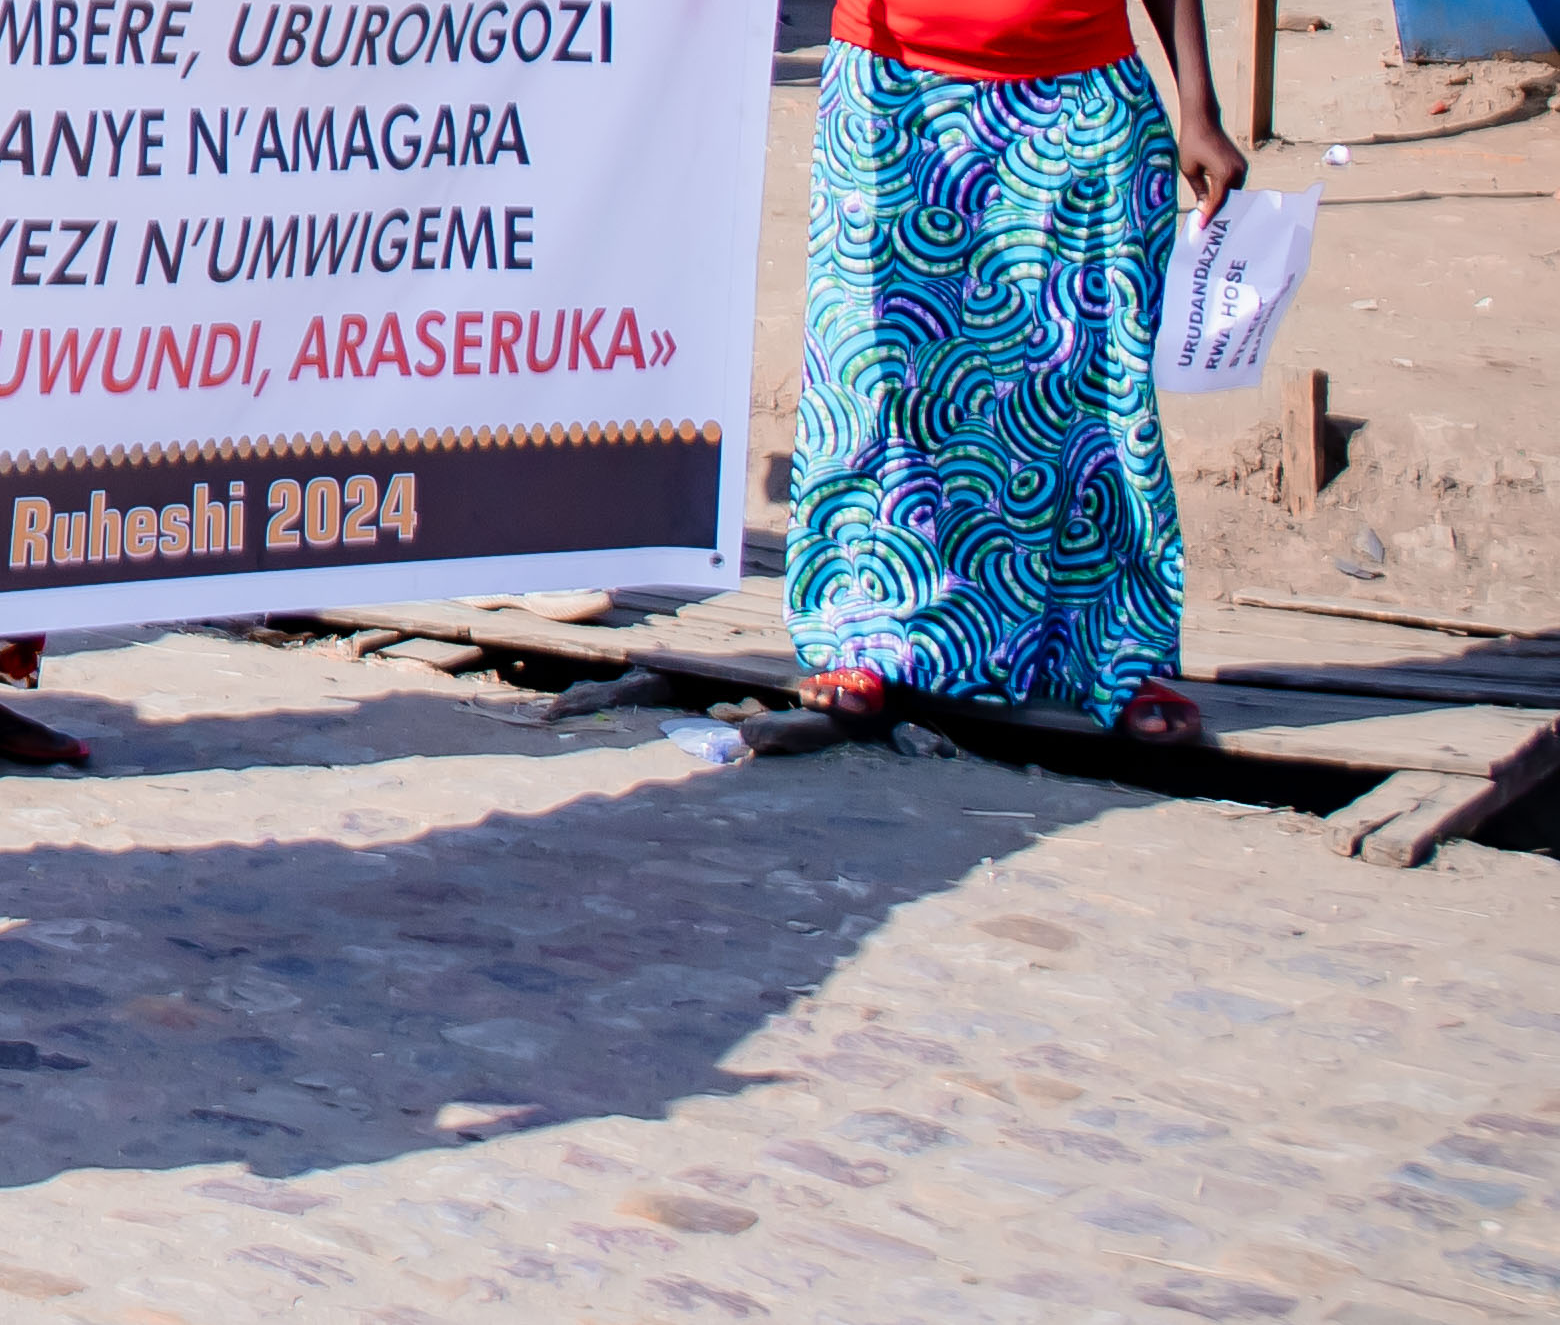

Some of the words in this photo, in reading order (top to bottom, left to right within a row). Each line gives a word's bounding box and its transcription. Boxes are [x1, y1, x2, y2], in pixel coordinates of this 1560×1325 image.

[187, 101, 531, 175] N'AMAGARA
[136, 206, 534, 286] N'UMWIGEME
[1178, 218, 1231, 367] URUDANDAZWA
[1206, 329, 1230, 369] RWA
[1221, 260, 1247, 318] HOSE
[287, 306, 678, 383] ARASERUKA»
[10, 481, 245, 569] Ruheshi
[267, 472, 418, 549] 2024
